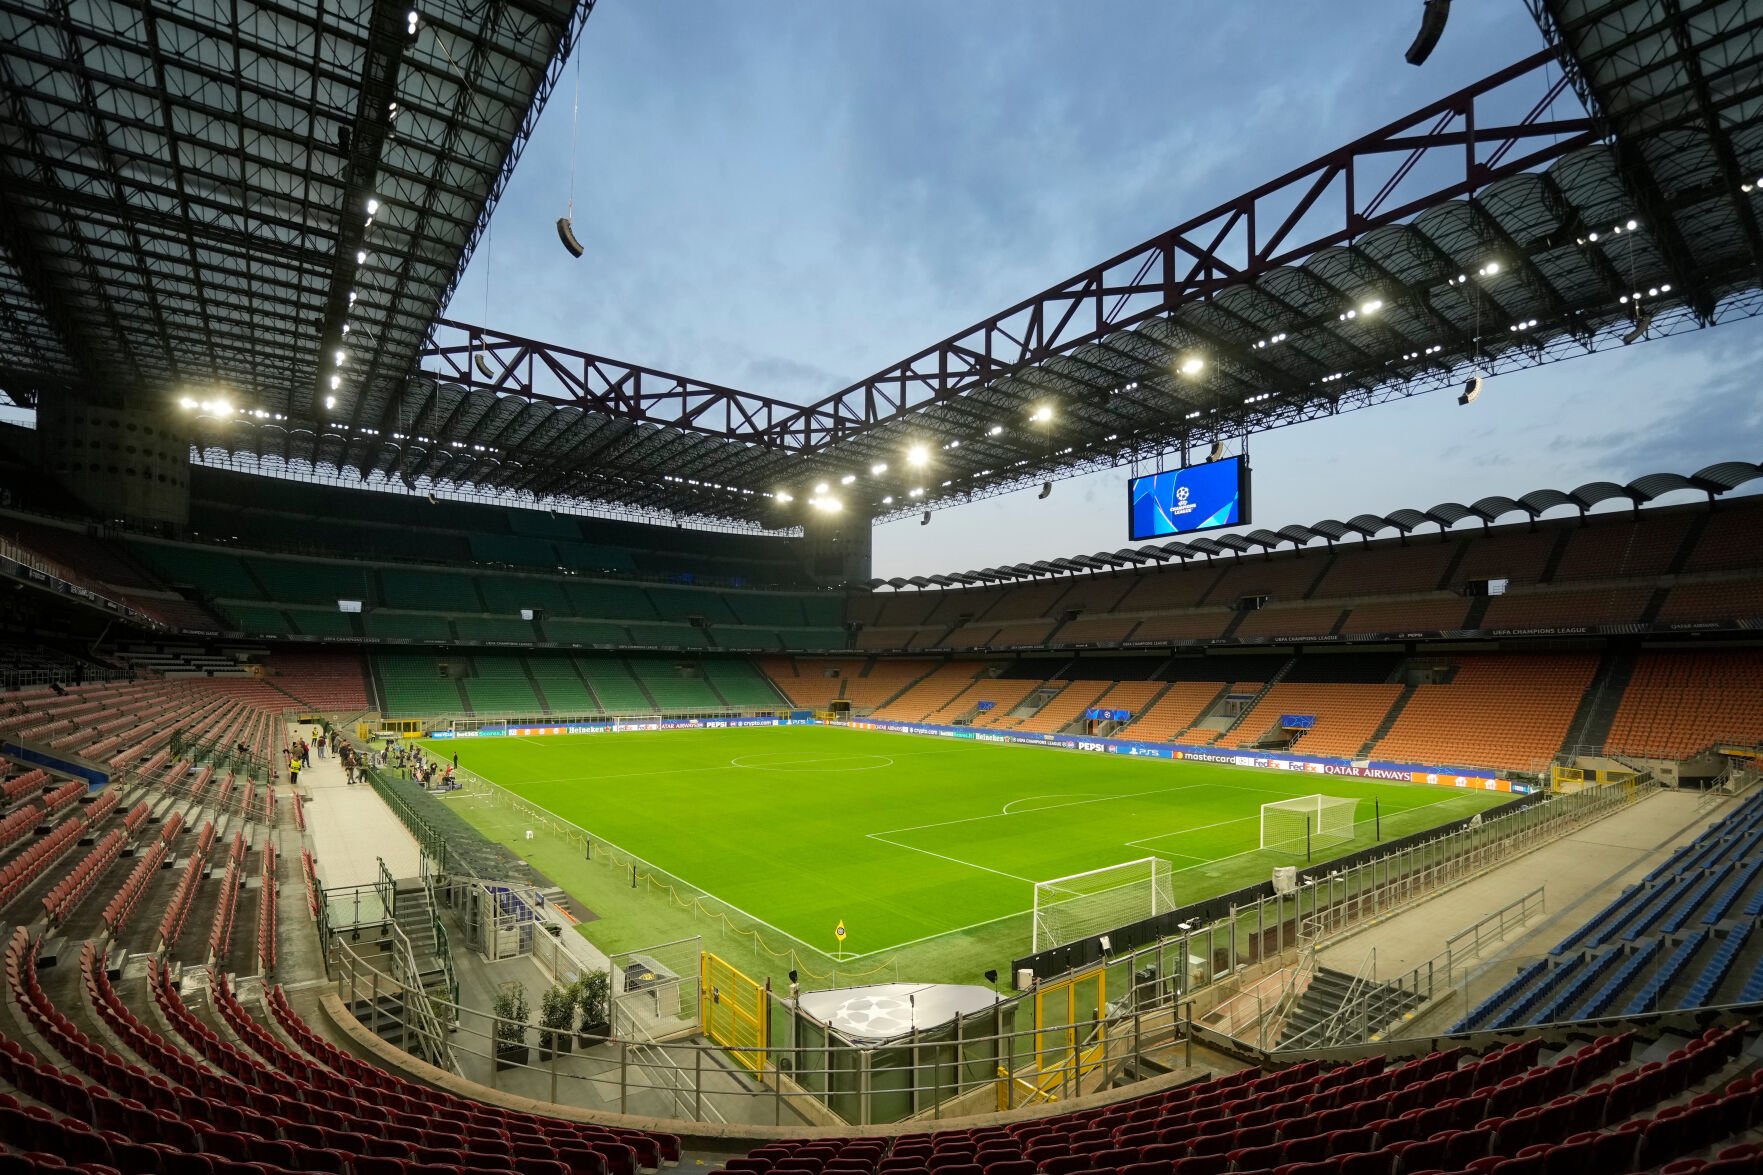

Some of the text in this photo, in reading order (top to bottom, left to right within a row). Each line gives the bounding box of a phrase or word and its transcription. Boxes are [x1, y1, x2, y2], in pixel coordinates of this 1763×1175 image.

[1512, 627, 1555, 635] CHAMPIONS
[975, 733, 1005, 742] Heineken
[1078, 742, 1105, 752] PEPSI
[1139, 748, 1160, 756] PS5
[1184, 752, 1236, 764] mastercard
[1253, 758, 1280, 768] FedEx
[1288, 761, 1317, 772] FedEx
[1325, 765, 1411, 780] QATAR AIRWAYS
